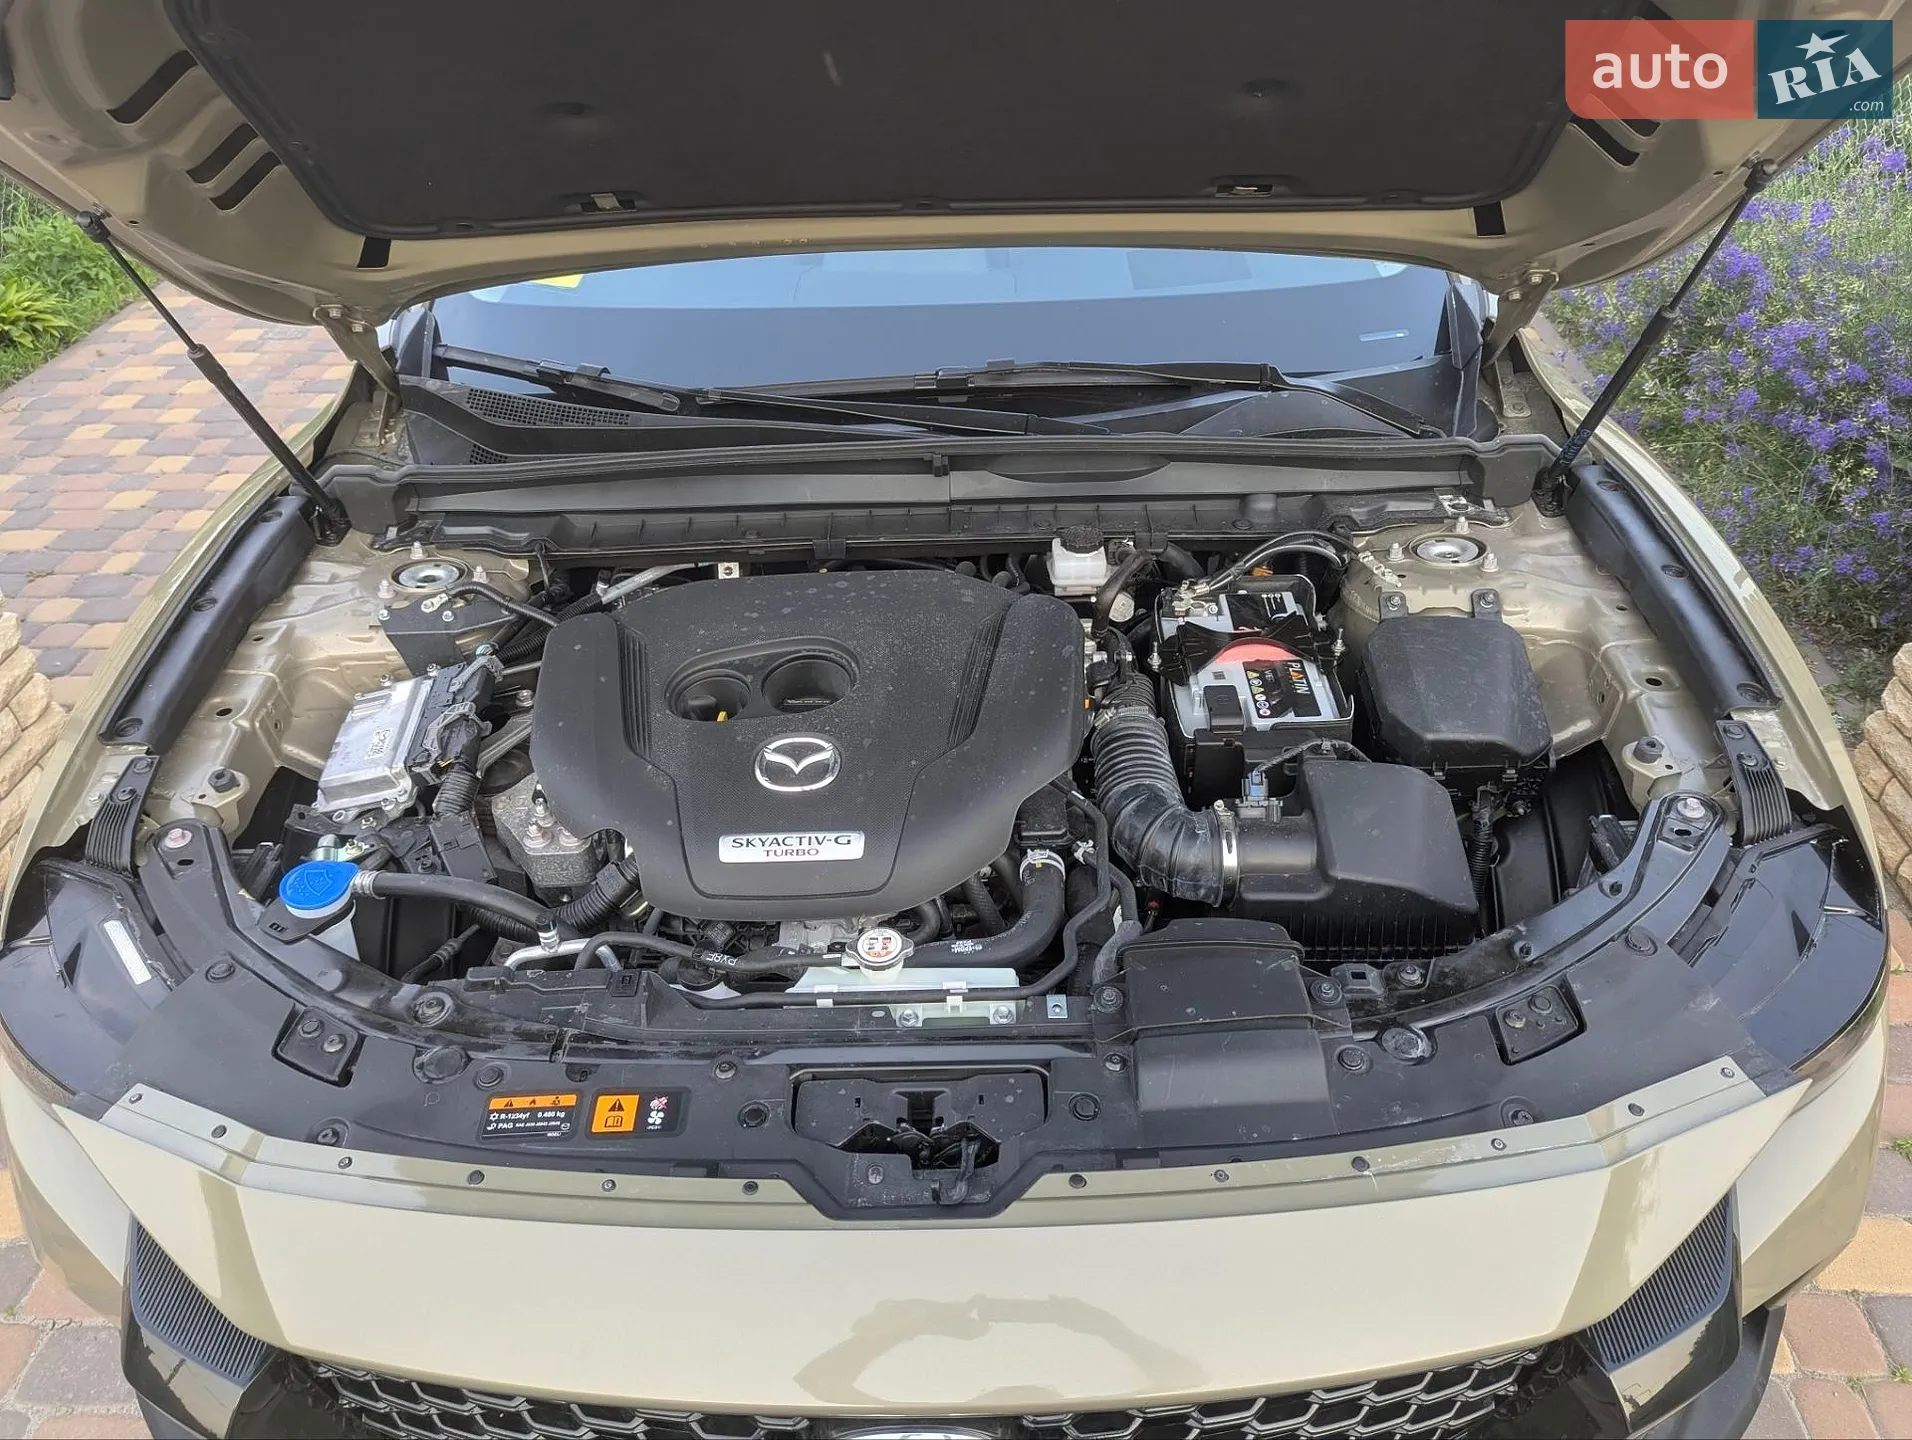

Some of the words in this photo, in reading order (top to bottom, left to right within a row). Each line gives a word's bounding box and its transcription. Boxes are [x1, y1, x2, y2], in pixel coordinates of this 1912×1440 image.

[1287, 662, 1311, 694] PLATIN
[731, 835, 852, 849] SKYACTIV-G
[763, 848, 819, 858] TURBO
[556, 1110, 566, 1118] kg
